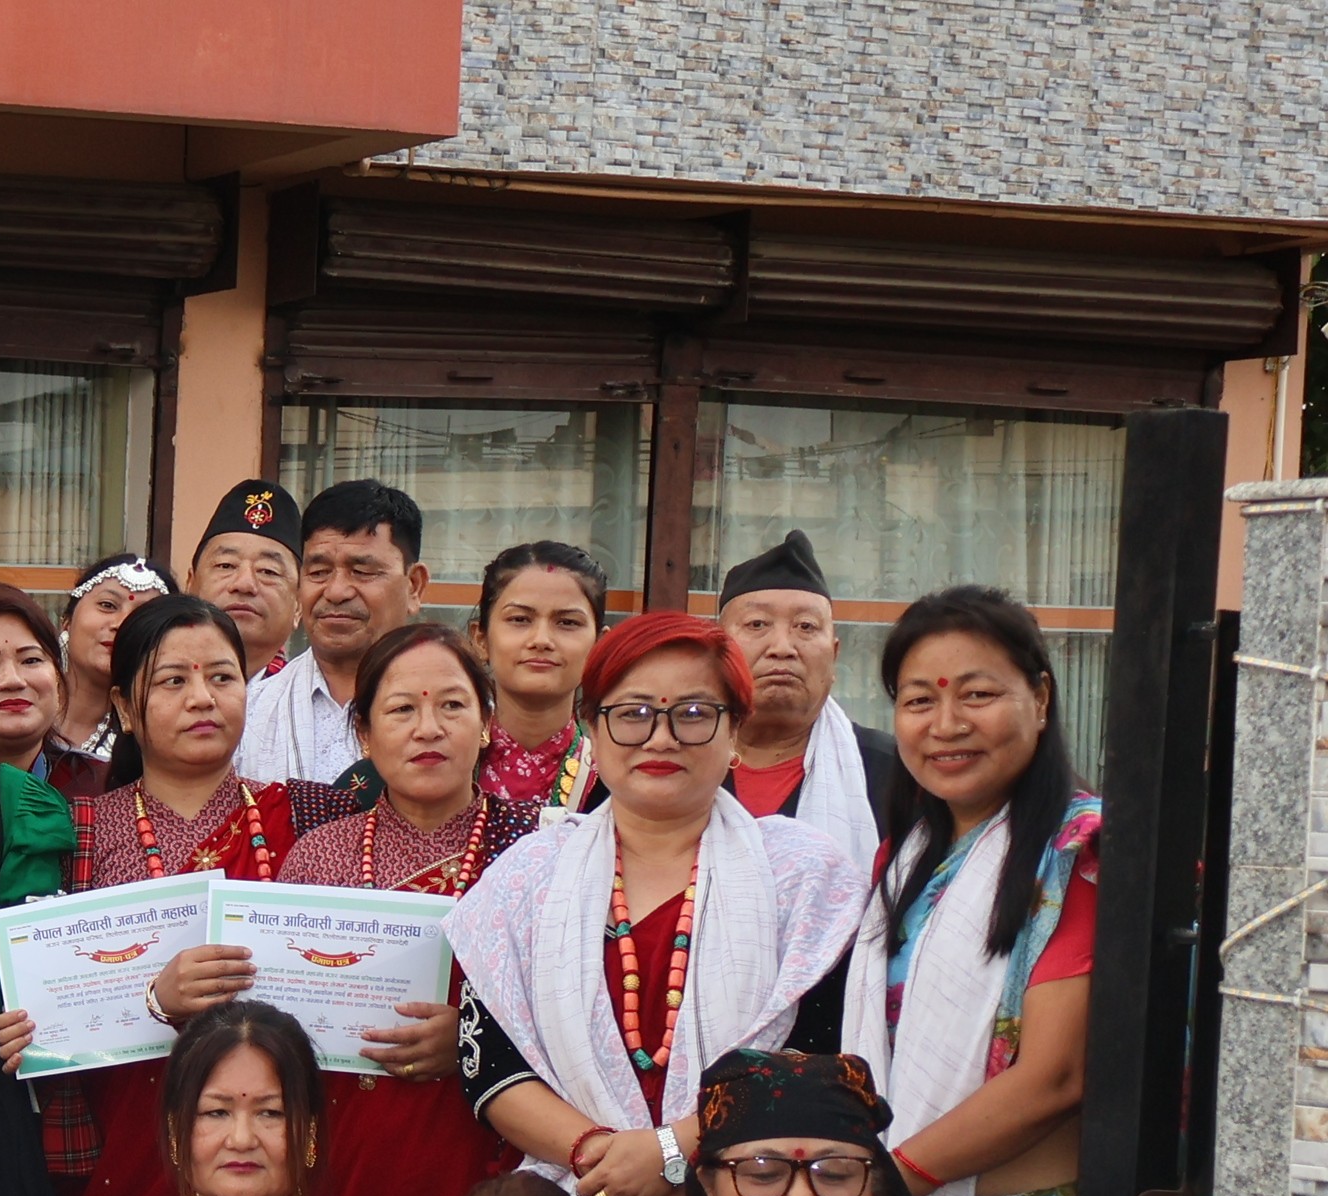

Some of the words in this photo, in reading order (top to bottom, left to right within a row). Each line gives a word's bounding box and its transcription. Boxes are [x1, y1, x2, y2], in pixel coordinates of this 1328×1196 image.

[32, 926, 63, 941] नेपाल
[64, 915, 112, 936] आदिवासी
[160, 903, 198, 920] महासंघ
[248, 909, 280, 927] नेपाल
[282, 912, 332, 931] आदिवासी
[382, 923, 422, 938] महासंघ
